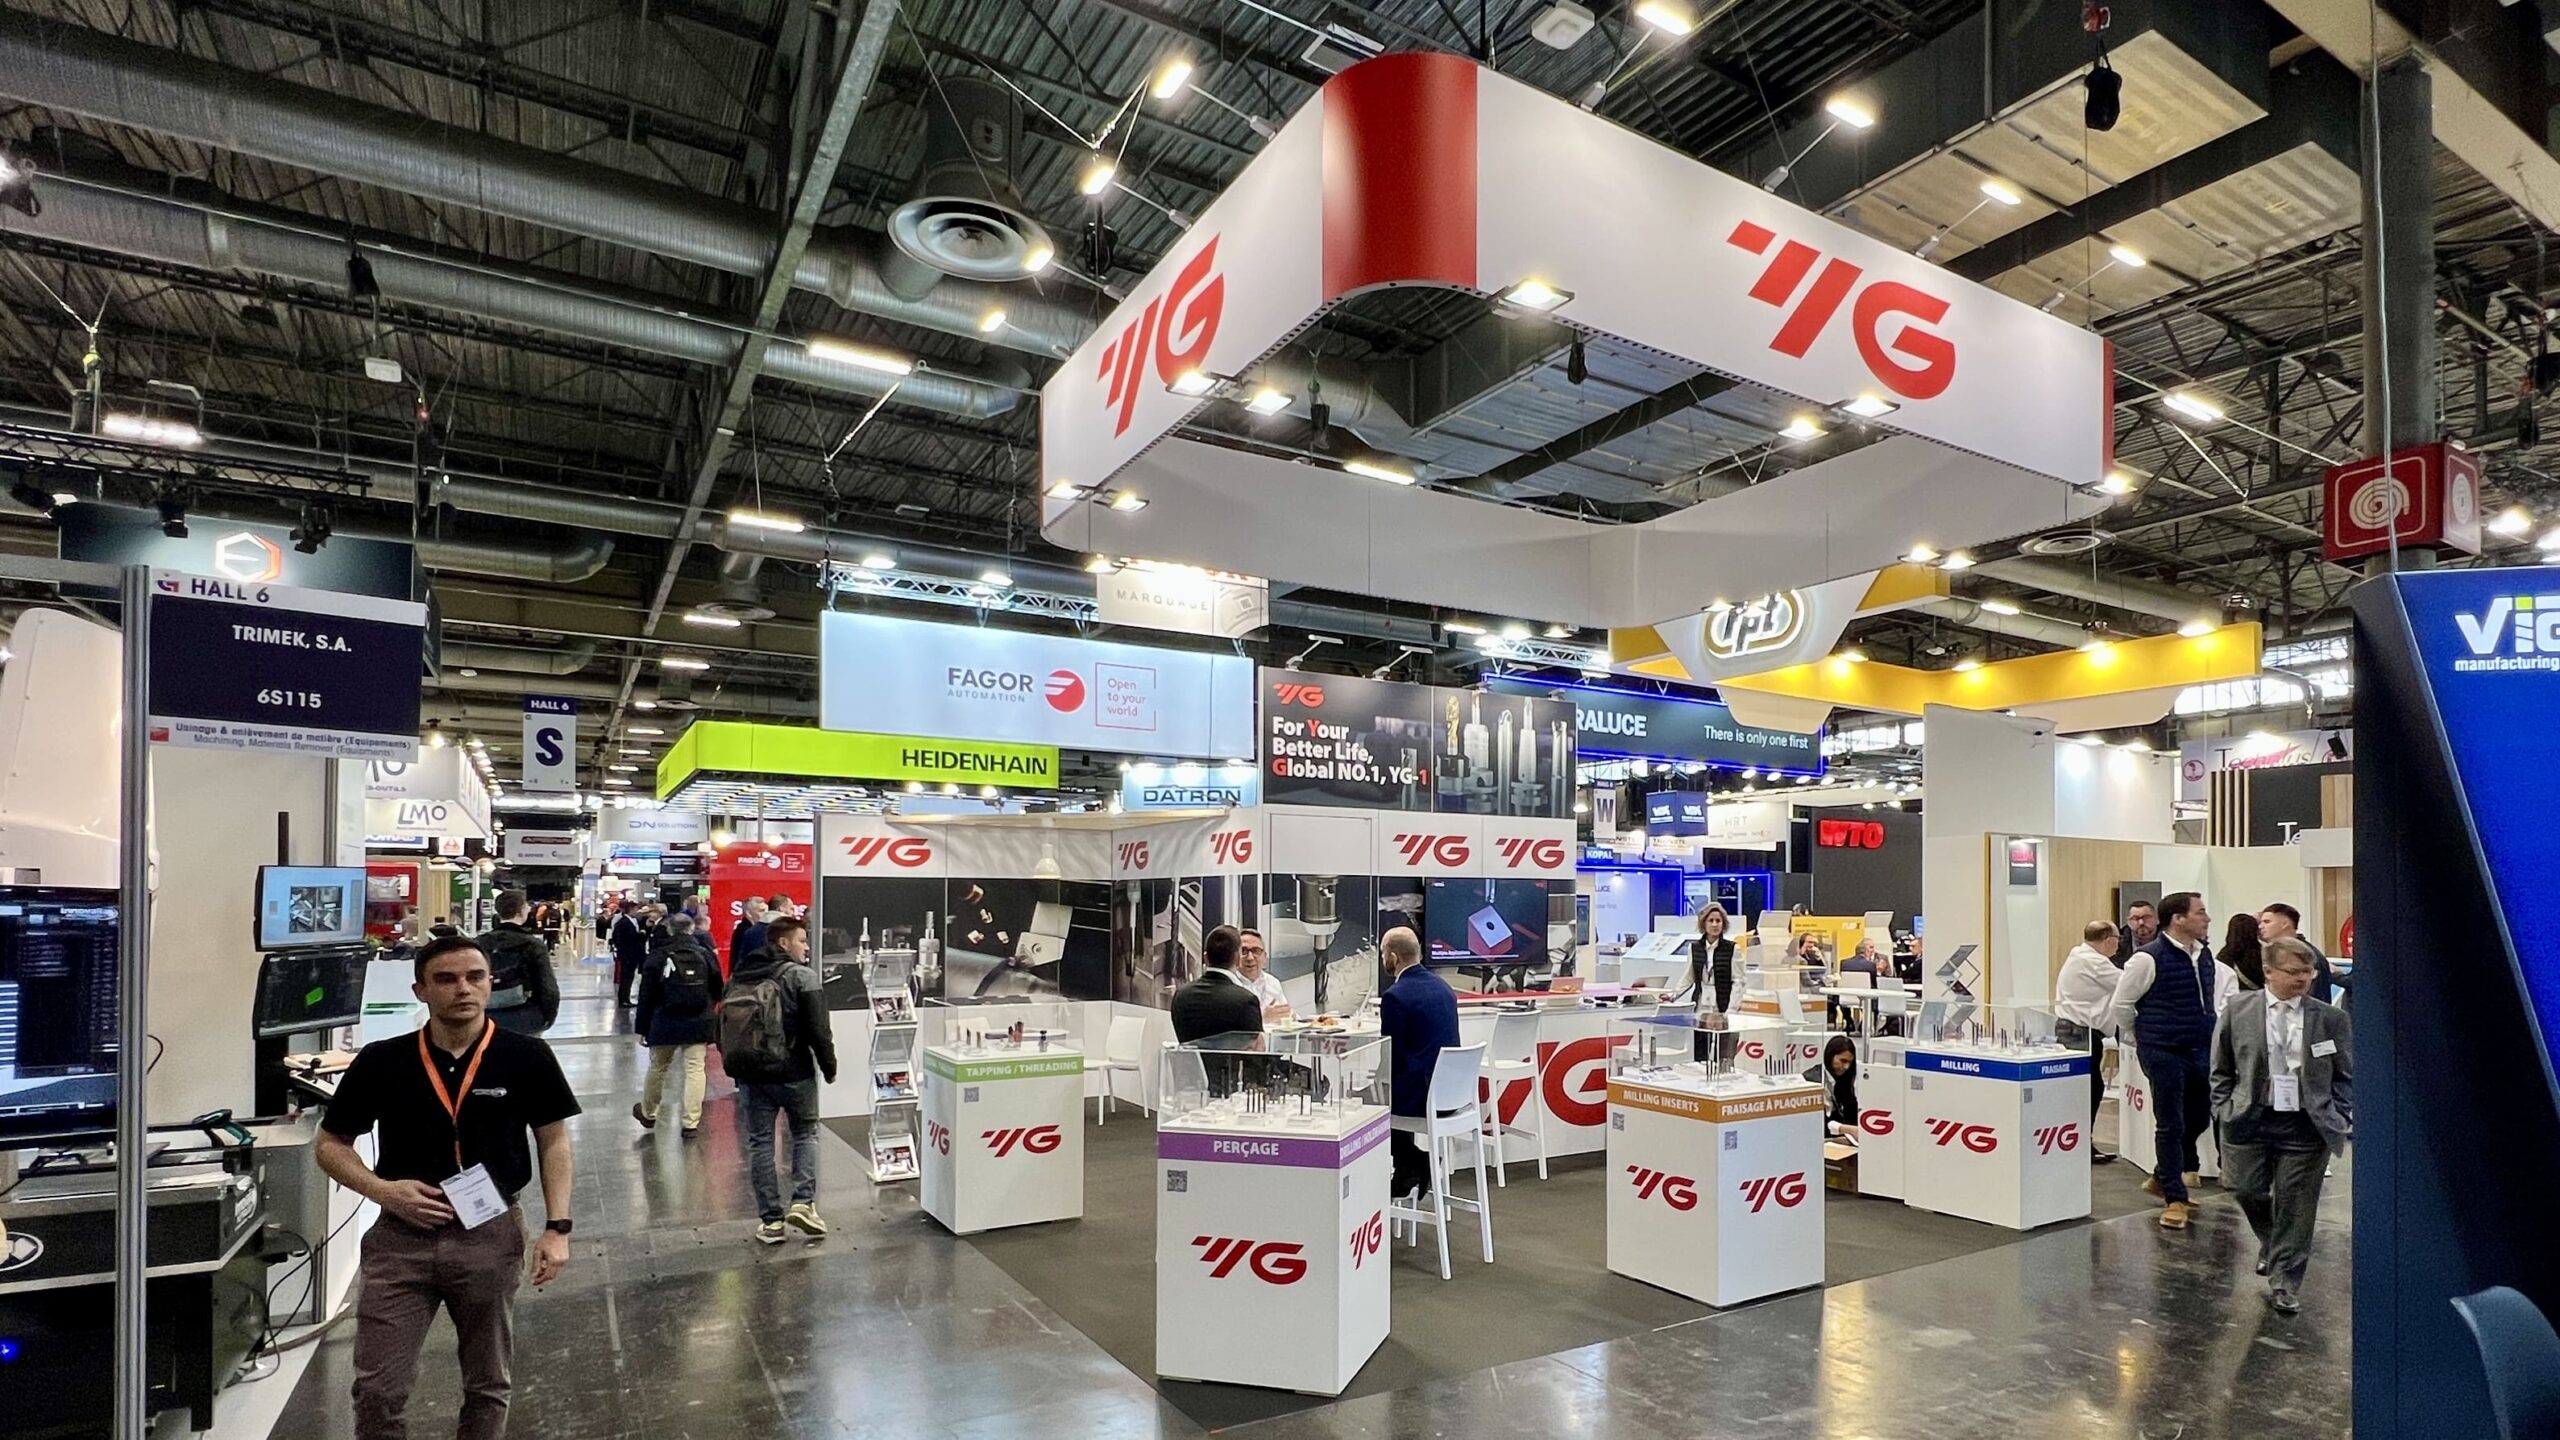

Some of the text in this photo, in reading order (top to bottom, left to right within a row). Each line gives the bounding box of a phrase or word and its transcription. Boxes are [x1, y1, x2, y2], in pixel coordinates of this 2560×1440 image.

[191, 578, 271, 603] HALL 6
[1116, 589, 1209, 611] MARQUAGE
[232, 624, 352, 652] TRIMEK, S.A.
[2454, 655, 2560, 672] manufacturing
[948, 667, 1033, 693] FAGOR
[1107, 677, 1137, 691] Open
[257, 688, 322, 709] 6S115
[531, 699, 569, 711] HALL 6
[947, 688, 1026, 703] AUTOMATION
[1107, 691, 1147, 707] to your
[1107, 705, 1138, 718] world
[175, 721, 217, 738] Usinage
[220, 724, 228, 735] &
[1272, 716, 1350, 740] For Your
[1704, 725, 1809, 749] There is only one first
[249, 738, 292, 750] Materials
[535, 727, 564, 767] S
[1272, 736, 1374, 764] Better Life,
[902, 748, 1048, 776] HEIDENHAIN
[1272, 756, 1428, 787] Global NO.1, YG-1
[1143, 788, 1241, 803] DATRON
[398, 802, 447, 826] LMO
[1596, 798, 1614, 823] W
[629, 821, 656, 829] DN
[1820, 820, 1884, 849] WTO
[1586, 850, 1614, 860] KOPAL
[966, 1065, 1012, 1077] TAPPING
[1019, 1061, 1078, 1073] THREADING
[1940, 1060, 1980, 1073] MILLING
[2041, 1063, 2070, 1075] FRAISAGE
[1623, 1089, 1700, 1113] MILLING INSERTS
[1721, 1094, 1822, 1117] FRAISAGE À PLAQUETTE
[1213, 1140, 1280, 1158] PERÇAGE
